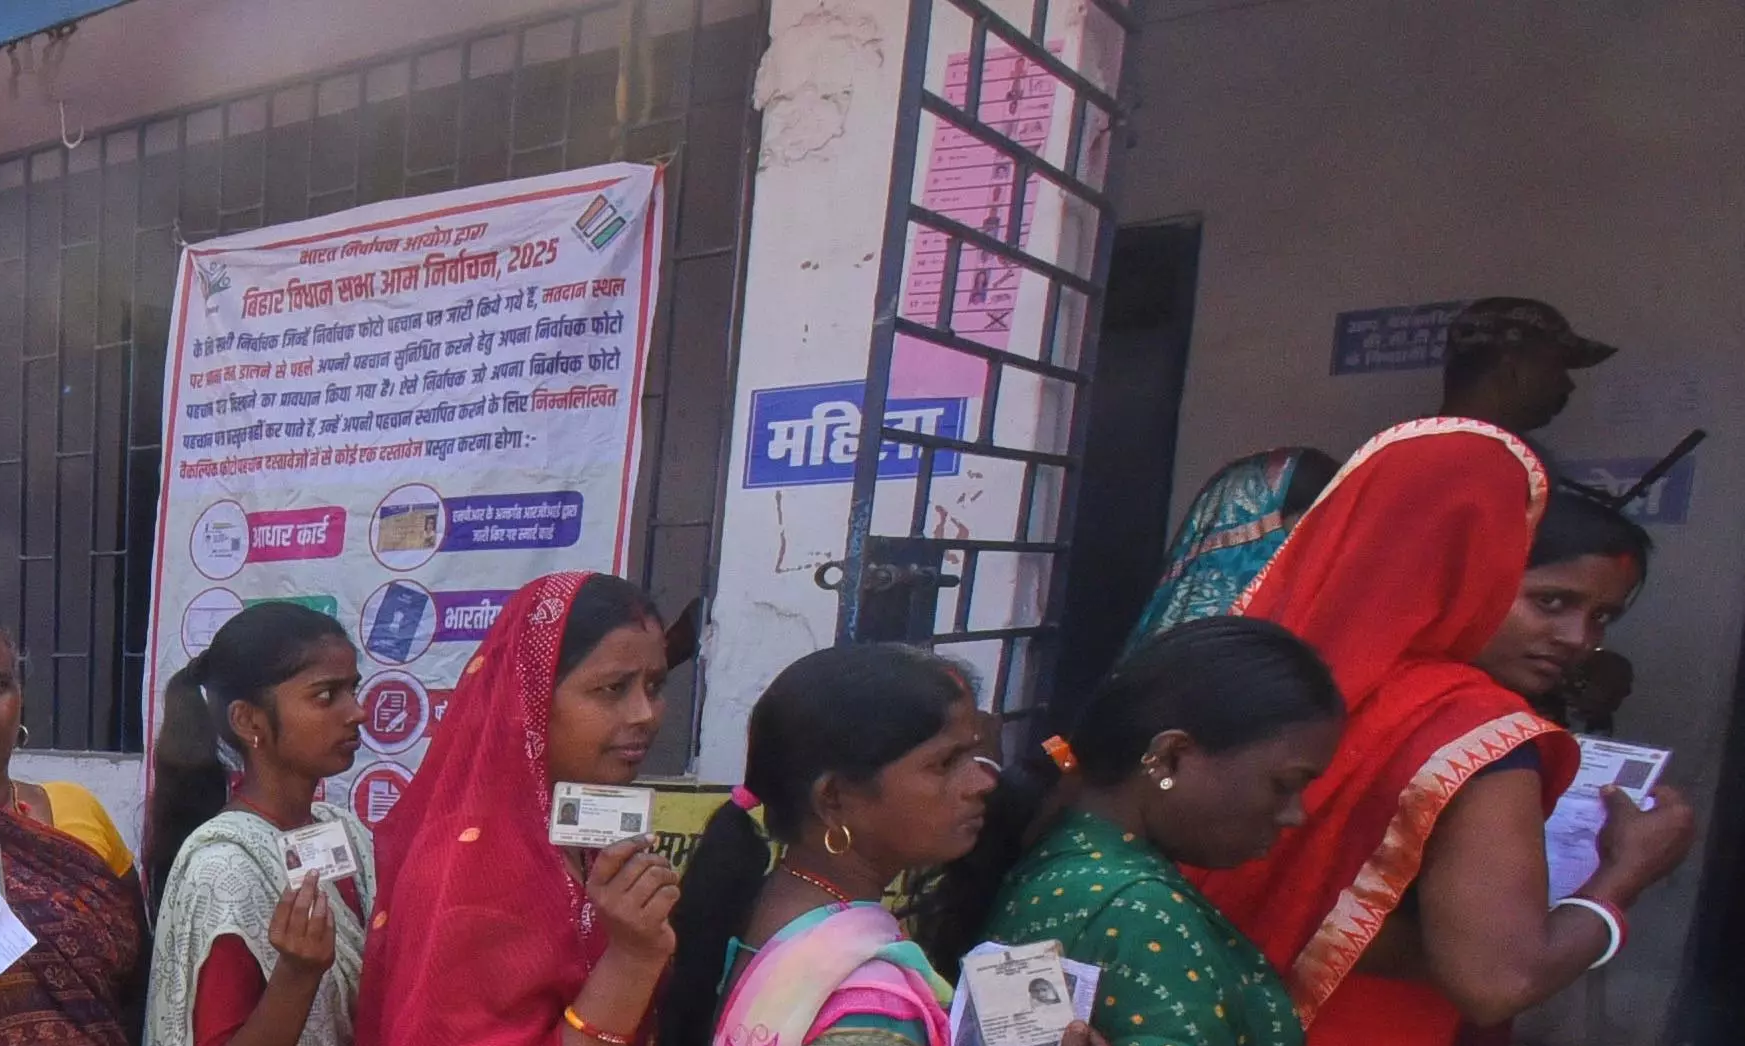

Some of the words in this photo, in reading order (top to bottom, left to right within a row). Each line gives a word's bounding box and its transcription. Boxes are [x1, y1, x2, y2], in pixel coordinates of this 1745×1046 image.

[299, 247, 337, 265] भारत
[403, 225, 453, 252] आयोग
[454, 222, 489, 246] द्वारा
[241, 286, 284, 319] बिहार
[287, 277, 333, 312] विधान
[335, 272, 374, 303] सभा
[380, 264, 421, 296] आम
[423, 248, 502, 288] निर्वाचन,
[507, 237, 560, 273] 2025
[282, 326, 312, 348] जिन्हें
[313, 322, 356, 345] निर्वाचक
[358, 315, 384, 338] फोटो
[388, 312, 423, 334] पहचान
[426, 309, 443, 327] पत्र
[445, 299, 474, 324] जारी
[476, 293, 502, 318] किये
[504, 288, 524, 313] गये
[542, 281, 588, 304] मतदान
[591, 278, 626, 298] स्थल
[189, 372, 204, 389] पर
[238, 361, 272, 380] डालने
[275, 359, 287, 379] से
[290, 355, 314, 377] पहले
[317, 352, 351, 373] अपनी
[353, 351, 392, 370] पहचान
[444, 330, 475, 357] करने
[476, 329, 496, 356] हेतु
[498, 326, 532, 348] अपना
[535, 314, 589, 341] निर्वाचक
[591, 309, 624, 335] फोटो
[260, 392, 277, 408] का
[280, 390, 322, 408] प्रावधान
[325, 382, 352, 404] किया
[355, 383, 377, 400] गया
[399, 373, 419, 396] ऐसे
[423, 368, 468, 393] निर्वाचक
[471, 362, 487, 384] जो
[490, 360, 525, 381] अपना
[529, 350, 584, 377] निर्वाचक
[588, 346, 621, 371] फोटो
[183, 432, 213, 449] पहचान
[265, 422, 283, 438] कर
[285, 418, 306, 438] पाते
[318, 413, 343, 435] उन्हें
[342, 410, 374, 432] अपनी
[376, 410, 414, 431] पहचान
[415, 401, 458, 426] स्थापित
[458, 395, 487, 420] करने
[487, 393, 502, 415] के
[502, 391, 530, 414] लिए
[530, 384, 618, 412] निम्नलिखित
[321, 445, 333, 466] से
[334, 444, 358, 466] कोई
[359, 446, 378, 464] एक
[379, 437, 424, 462] दस्तावेज
[425, 438, 455, 462] प्रस्तुत
[457, 432, 492, 453] करना
[494, 426, 523, 451] होगा
[252, 524, 294, 549] आधार
[296, 515, 330, 546] कार्ड
